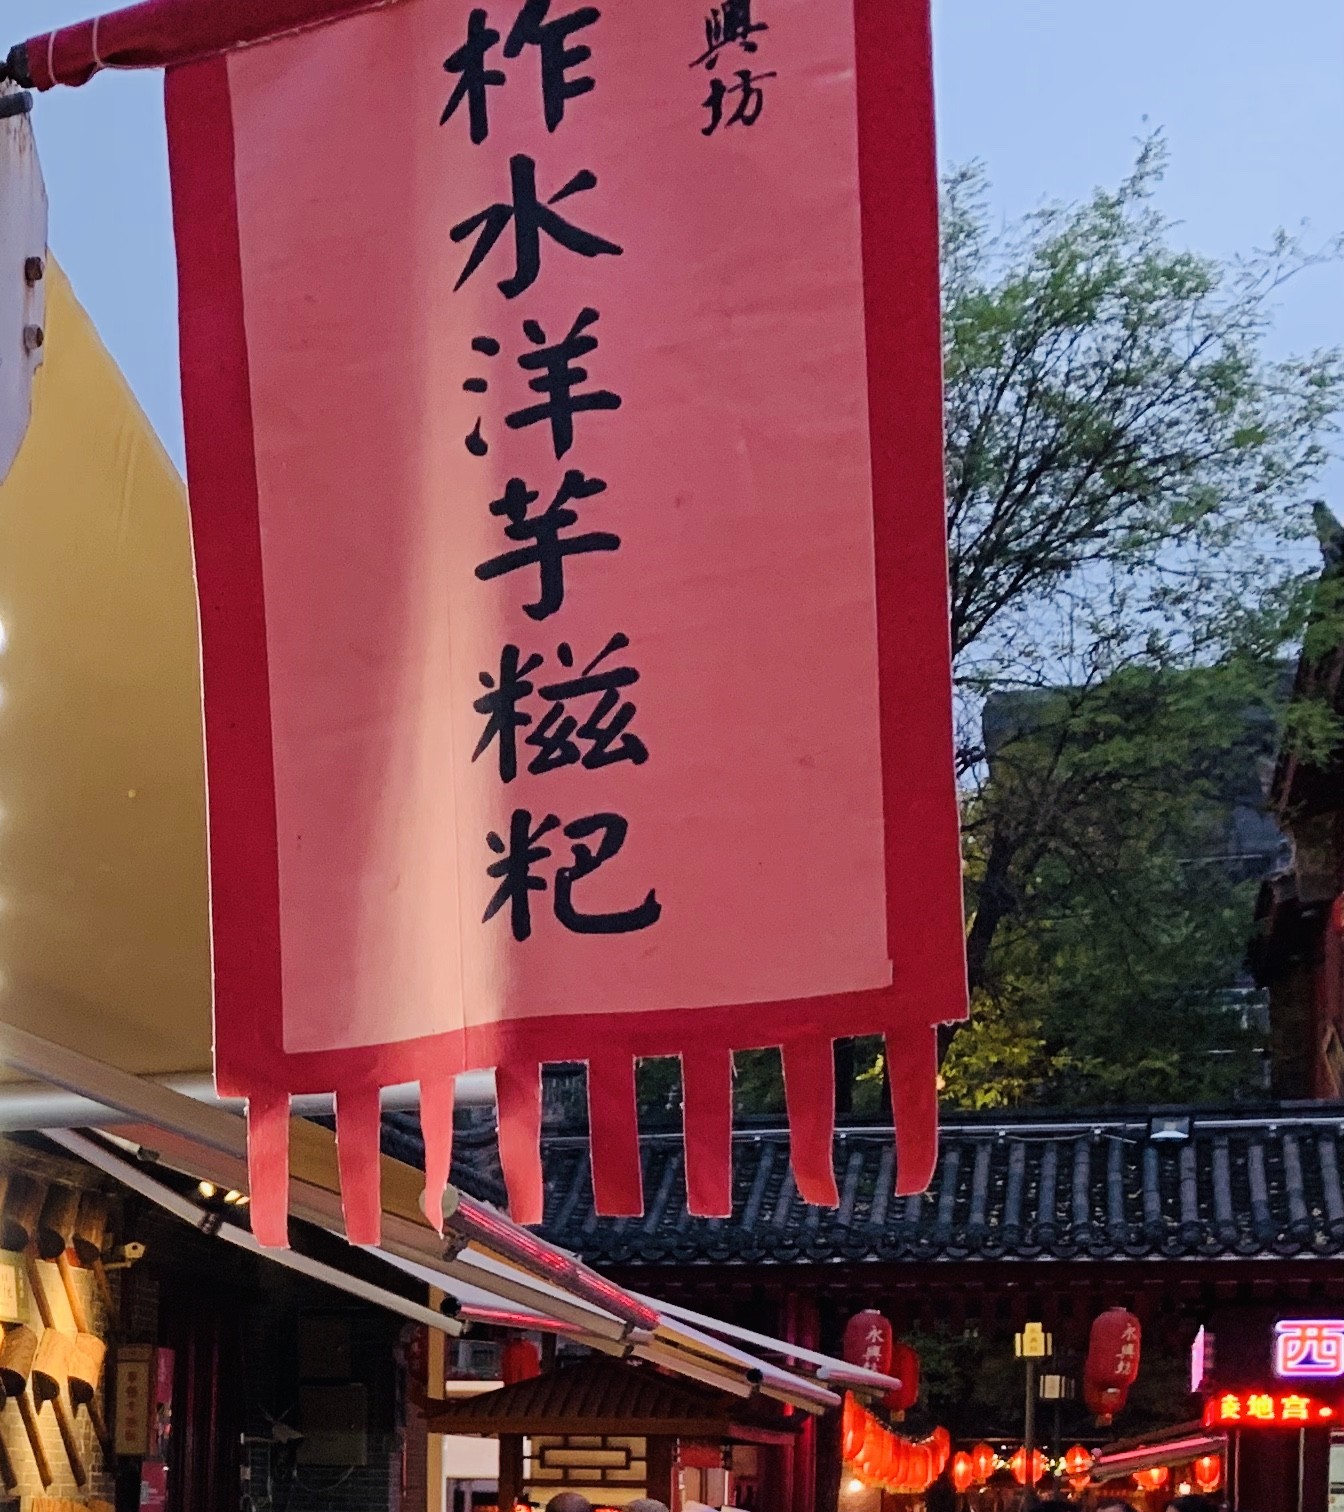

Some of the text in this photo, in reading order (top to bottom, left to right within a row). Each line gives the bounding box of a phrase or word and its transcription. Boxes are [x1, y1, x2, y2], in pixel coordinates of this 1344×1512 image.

[440, 0, 661, 942] 柞水洋芋糍粑
